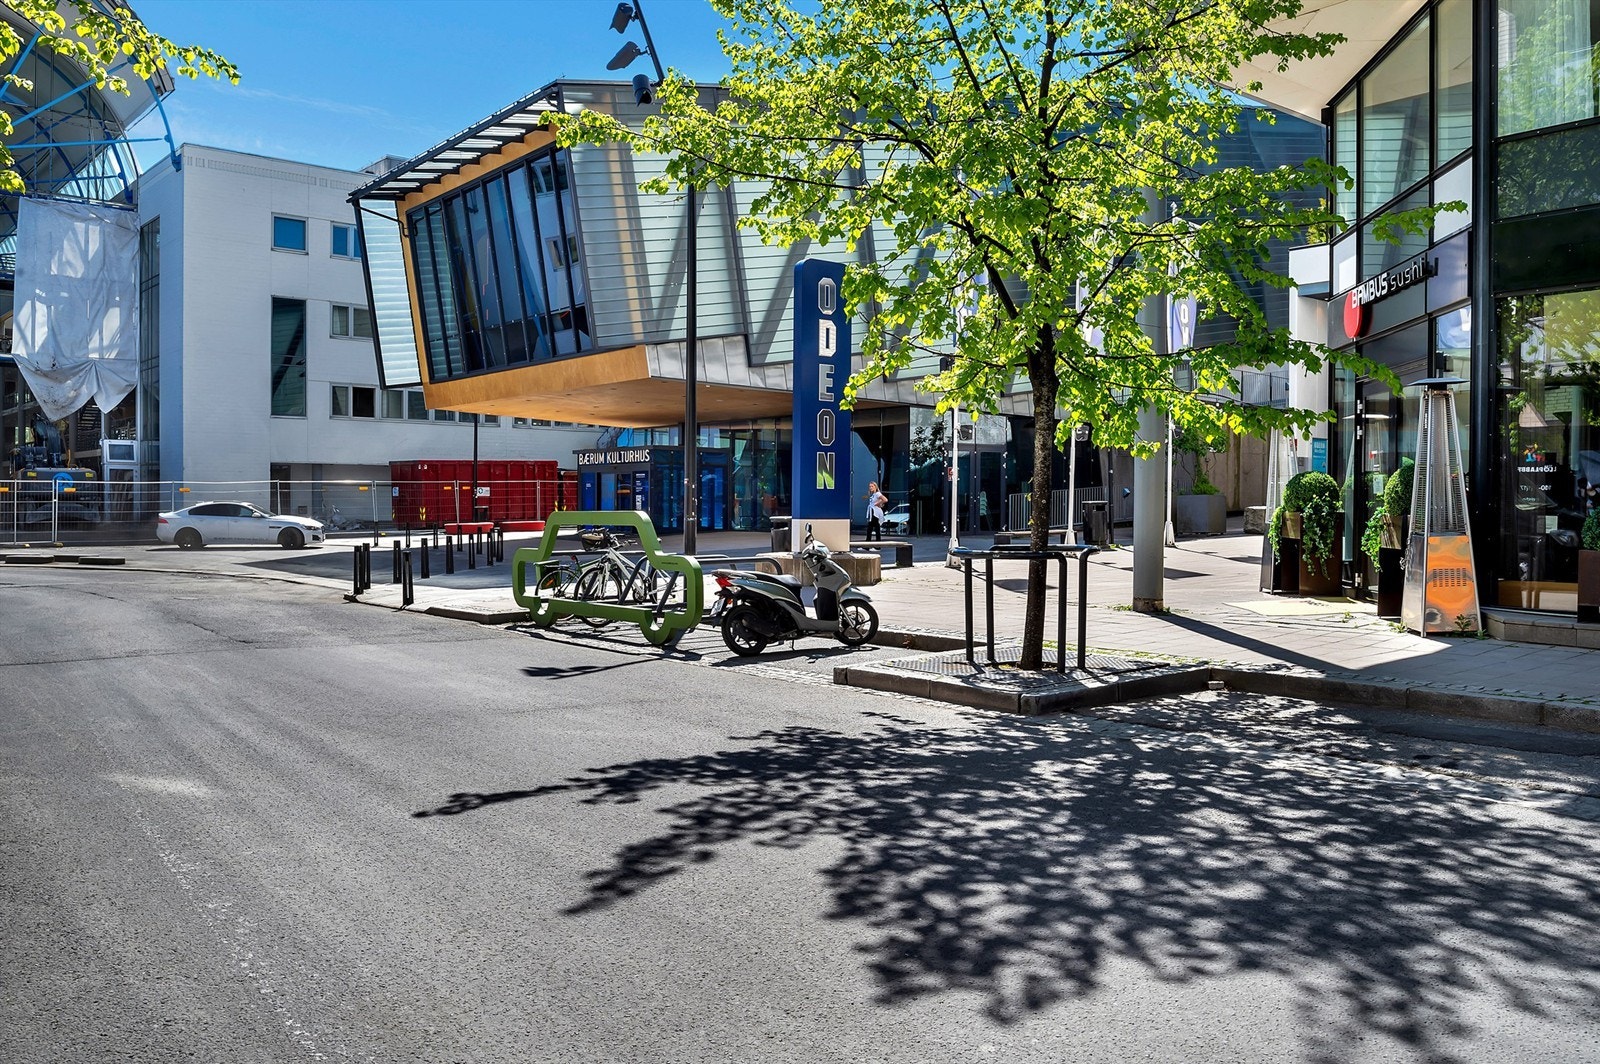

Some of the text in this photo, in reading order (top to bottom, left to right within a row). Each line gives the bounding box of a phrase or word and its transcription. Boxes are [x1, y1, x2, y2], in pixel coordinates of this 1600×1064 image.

[1351, 257, 1423, 309] BAMBUS sushi
[817, 277, 837, 490] ODEON
[578, 449, 650, 465] BÆRUM KULTURHUS
